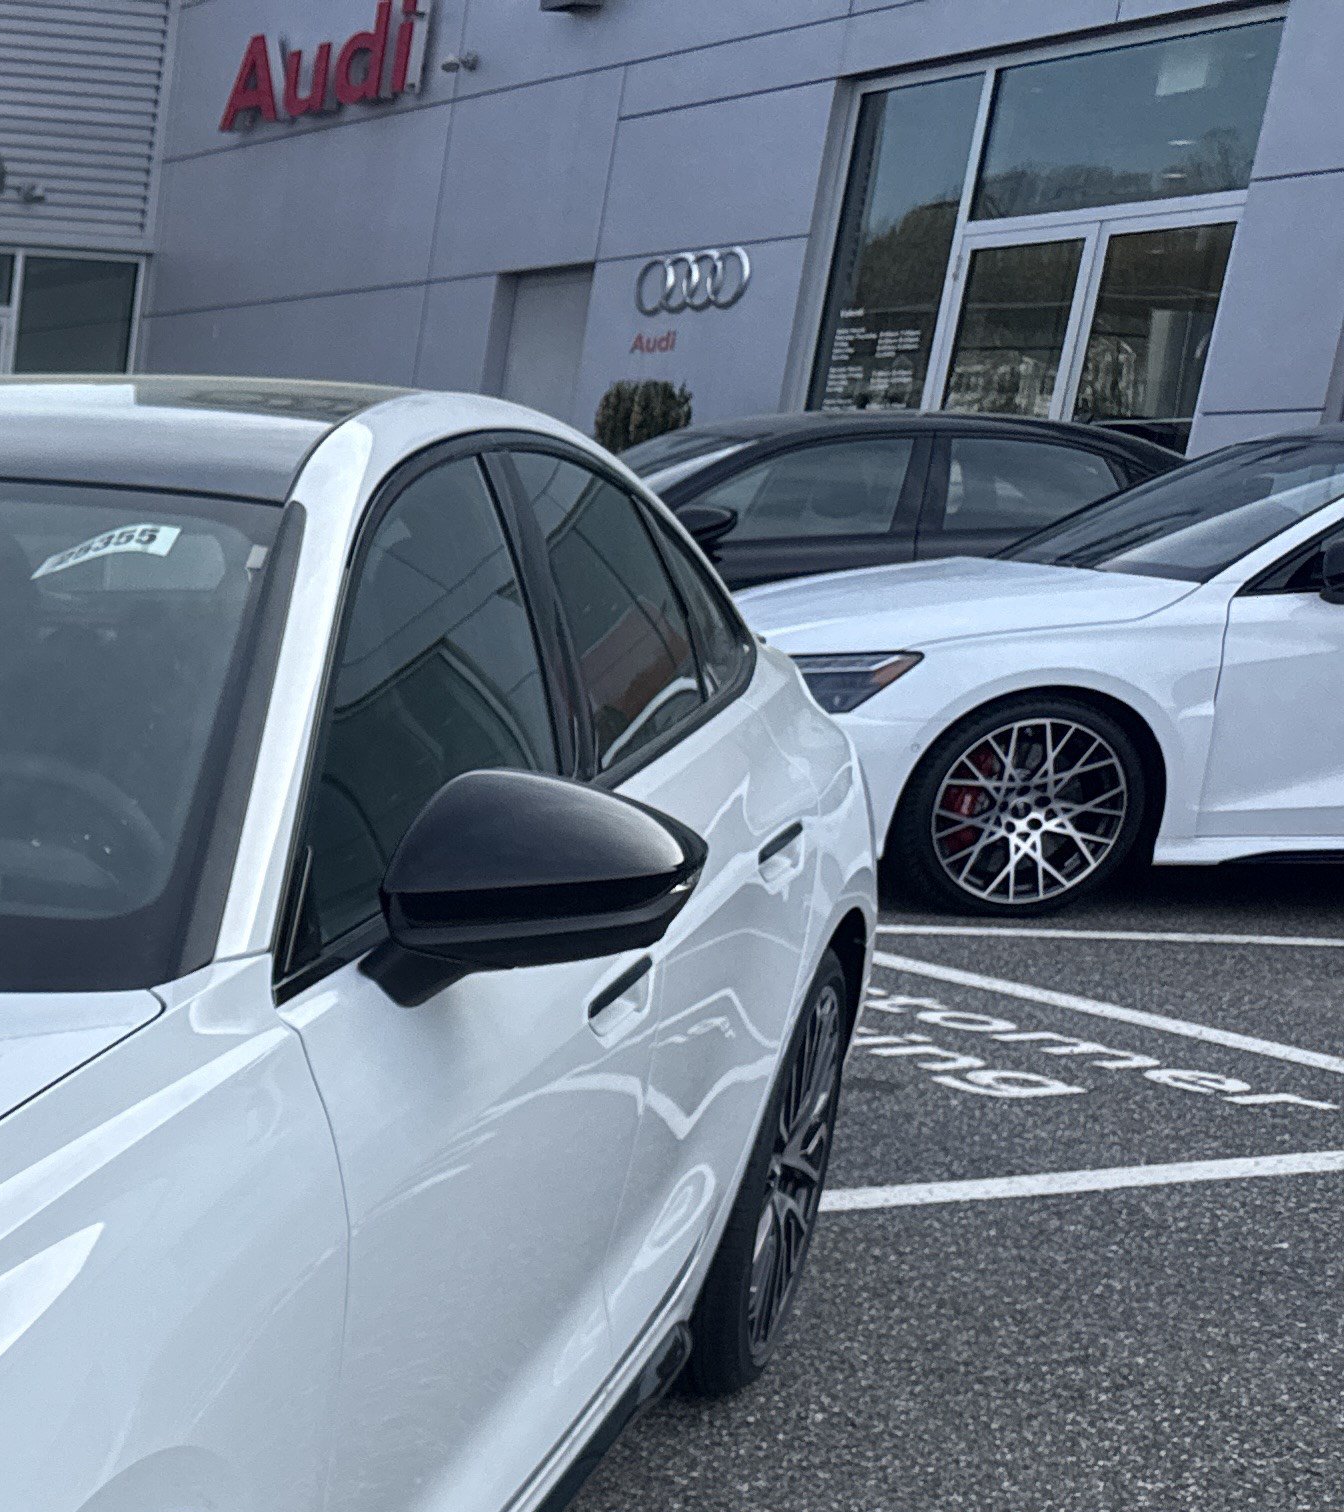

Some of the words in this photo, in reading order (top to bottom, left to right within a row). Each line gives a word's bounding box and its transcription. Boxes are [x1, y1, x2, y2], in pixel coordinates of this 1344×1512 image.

[218, 0, 419, 132] Audi
[629, 330, 677, 354] Audi
[865, 987, 1340, 1110] tomer
